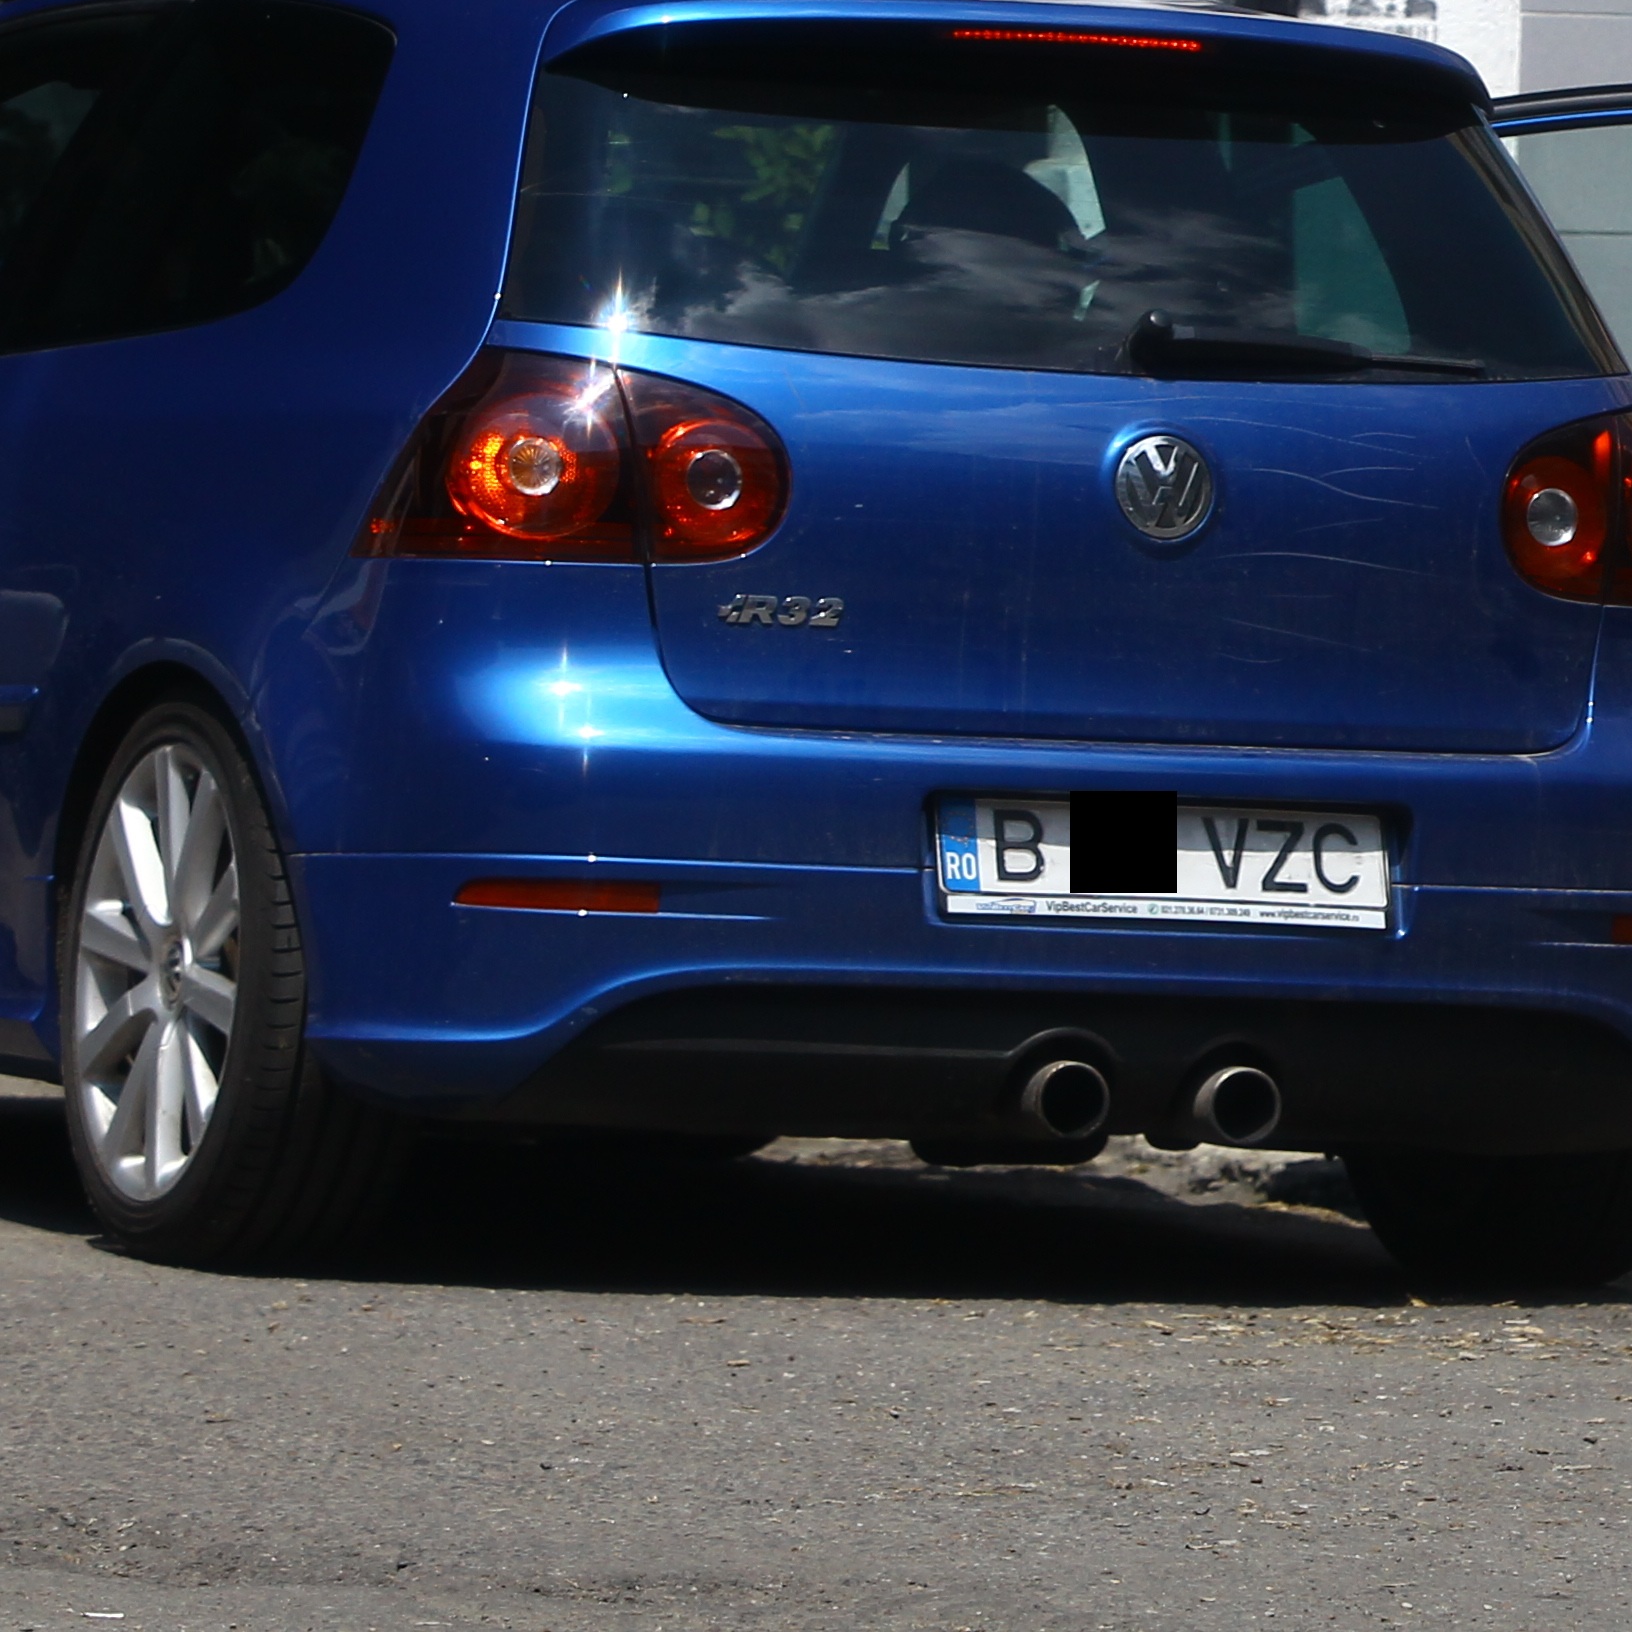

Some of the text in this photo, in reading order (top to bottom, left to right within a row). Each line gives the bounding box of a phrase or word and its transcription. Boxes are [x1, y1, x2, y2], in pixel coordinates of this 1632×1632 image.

[945, 809, 1361, 894] RO B VZC
[1045, 900, 1138, 914] VipBestCarService
